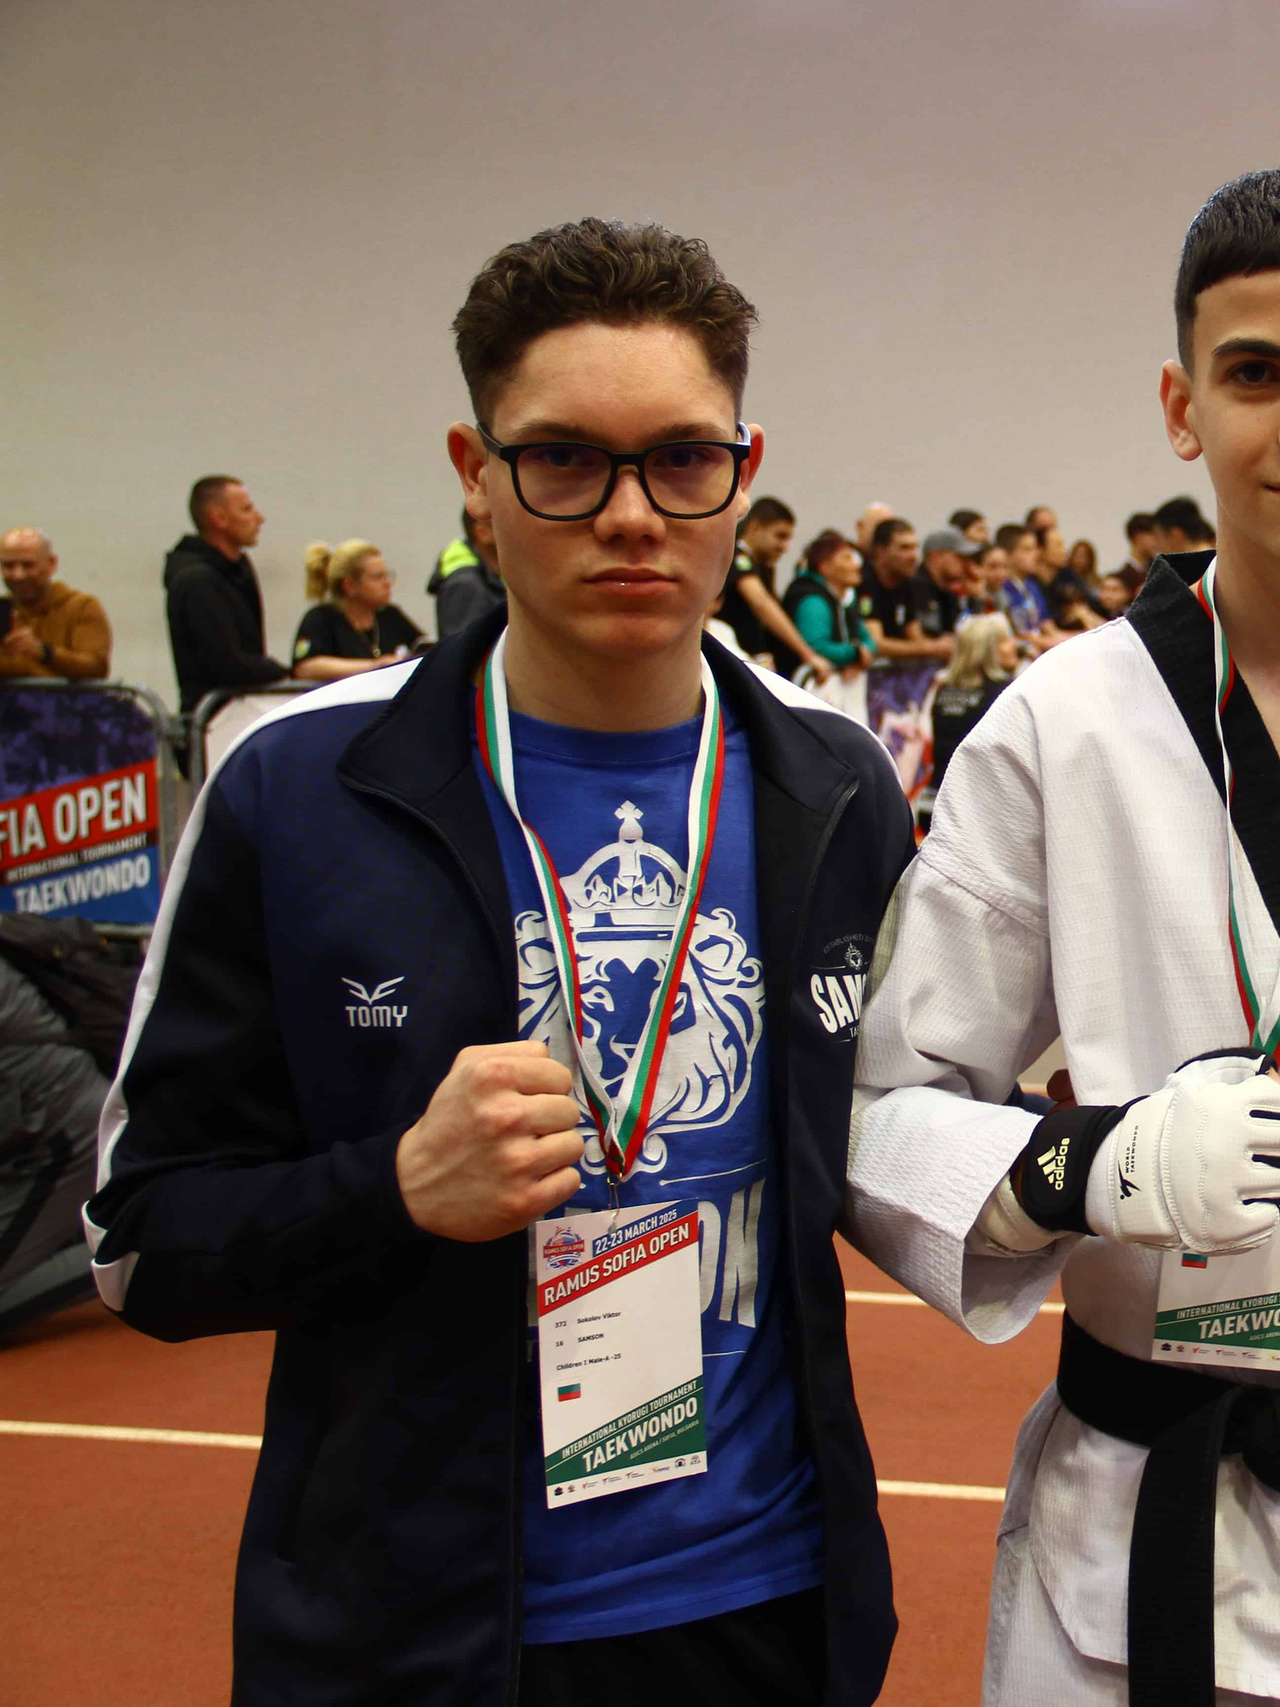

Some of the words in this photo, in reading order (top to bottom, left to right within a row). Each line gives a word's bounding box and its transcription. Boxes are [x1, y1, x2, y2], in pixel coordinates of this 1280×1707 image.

[52, 772, 147, 844] OPEN
[7, 851, 80, 884] INTERNATIONAL
[81, 833, 148, 861] TOURNAMENT
[13, 853, 151, 915] TAEKWONDO
[345, 1005, 408, 1028] TOMY
[1054, 1137, 1071, 1191] adidas
[1130, 1125, 1139, 1173] TAEKWONDO
[595, 1230, 623, 1254] 22-23
[624, 1216, 658, 1240] MARCH
[659, 1209, 677, 1225] 2025
[544, 1264, 600, 1306] RAMUS
[602, 1245, 647, 1277] SOFIA
[649, 1222, 690, 1255] OPEN
[577, 1315, 601, 1324] Sokolov
[602, 1312, 622, 1320] Viktor
[1176, 1301, 1241, 1320] INTERNATIONAL
[1241, 1296, 1278, 1309] KYORUGI
[578, 1333, 604, 1343] SAMSON
[556, 1361, 582, 1371] Children
[588, 1355, 609, 1364] Male-A
[562, 1424, 617, 1459] INTERNATIONAL
[617, 1407, 649, 1429] KYORUGI
[650, 1380, 698, 1410] TOURNAMENT
[582, 1396, 698, 1473] TAEKWONDO
